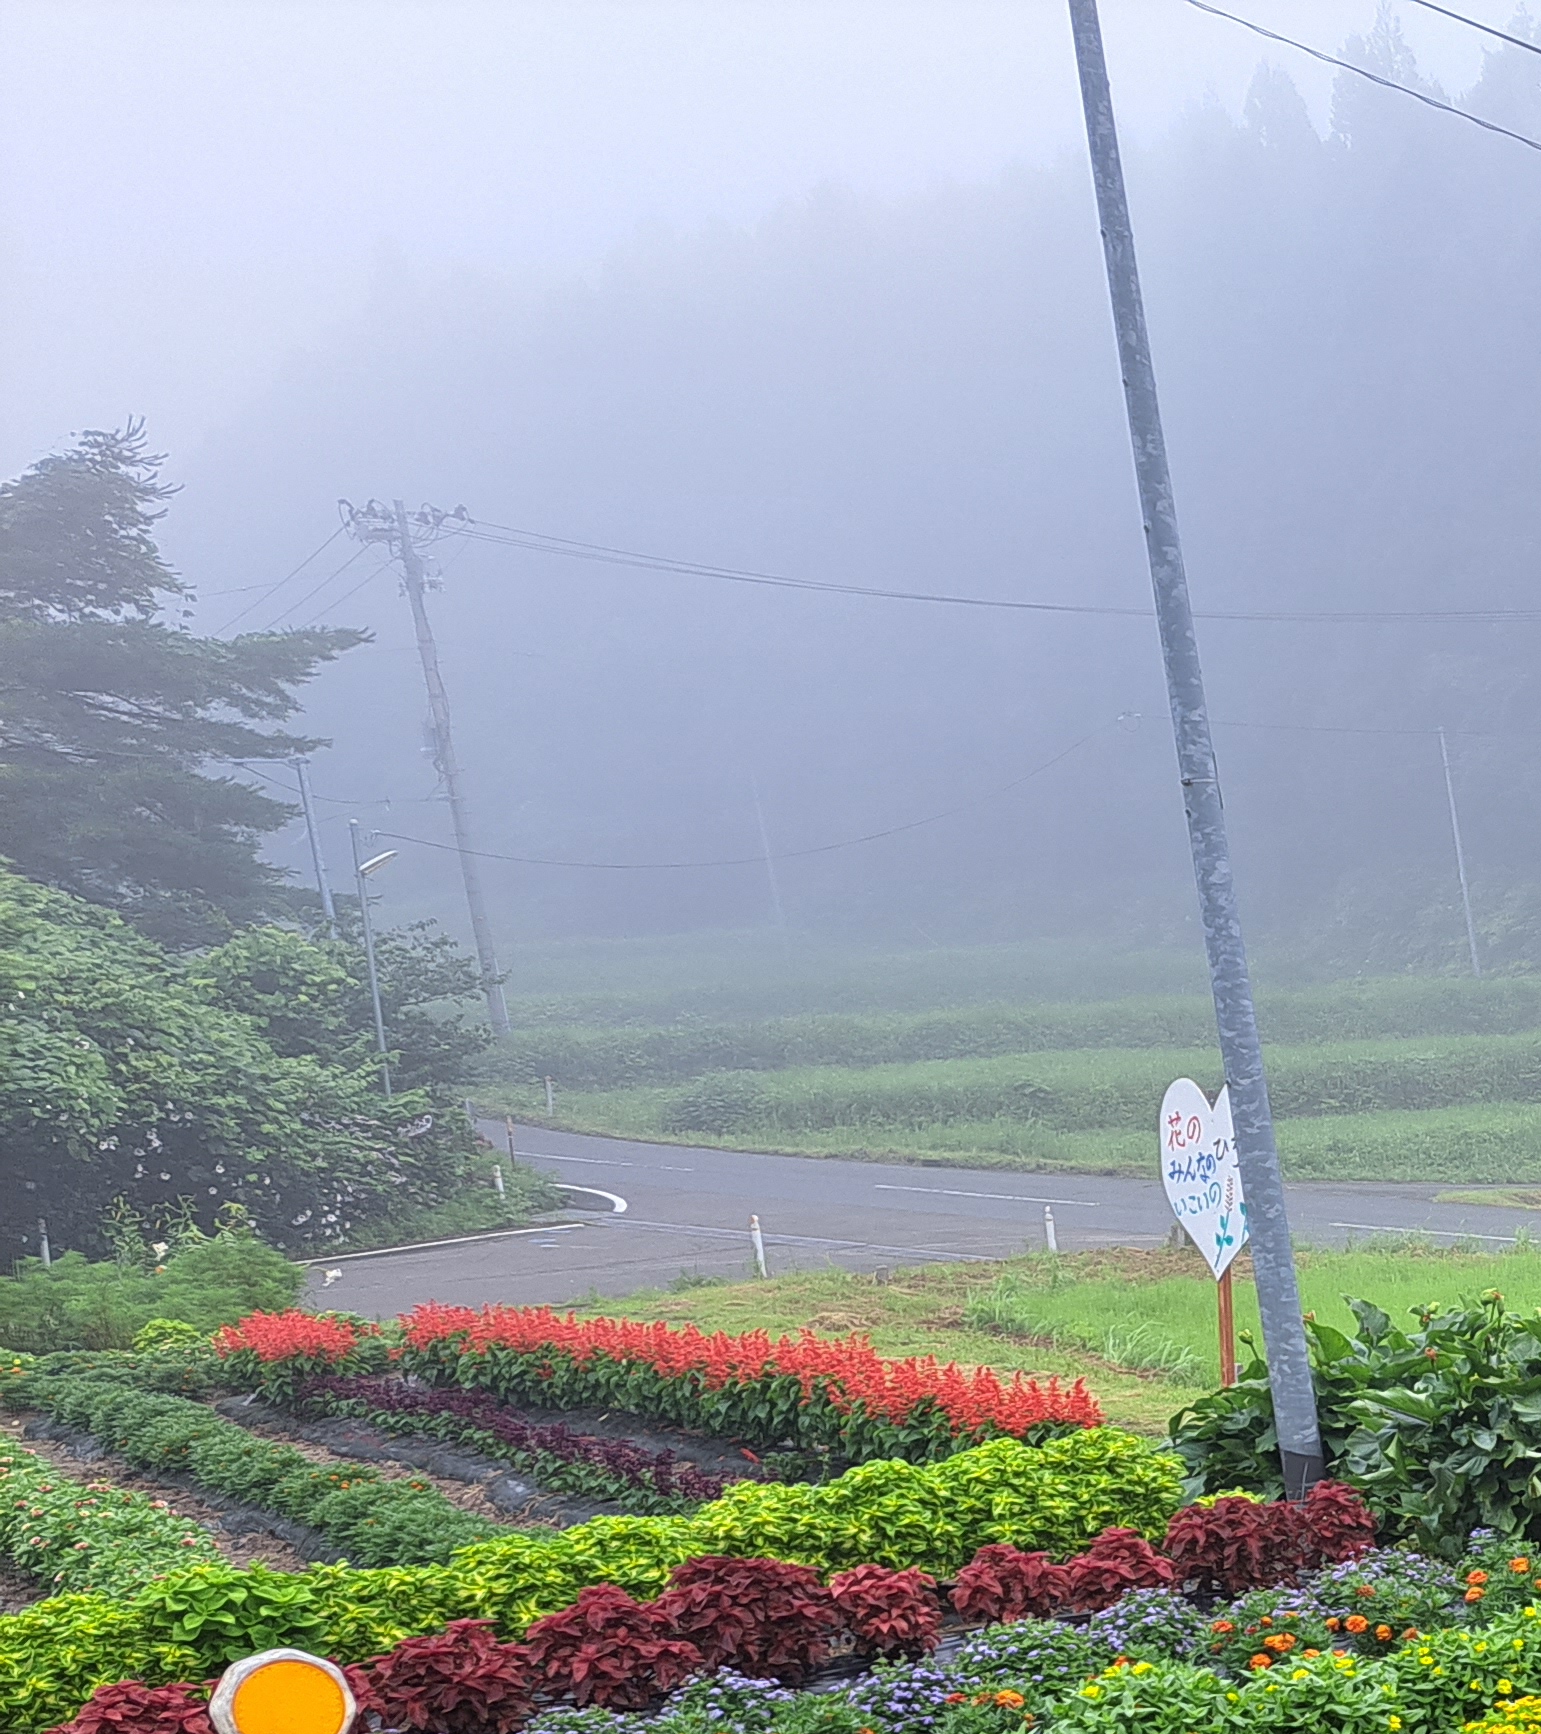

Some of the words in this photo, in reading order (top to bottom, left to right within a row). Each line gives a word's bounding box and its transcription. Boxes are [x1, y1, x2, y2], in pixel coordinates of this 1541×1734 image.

[1168, 1111, 1202, 1151] 花の
[1168, 1151, 1216, 1183] みんなの
[1174, 1182, 1222, 1216] いこいの
